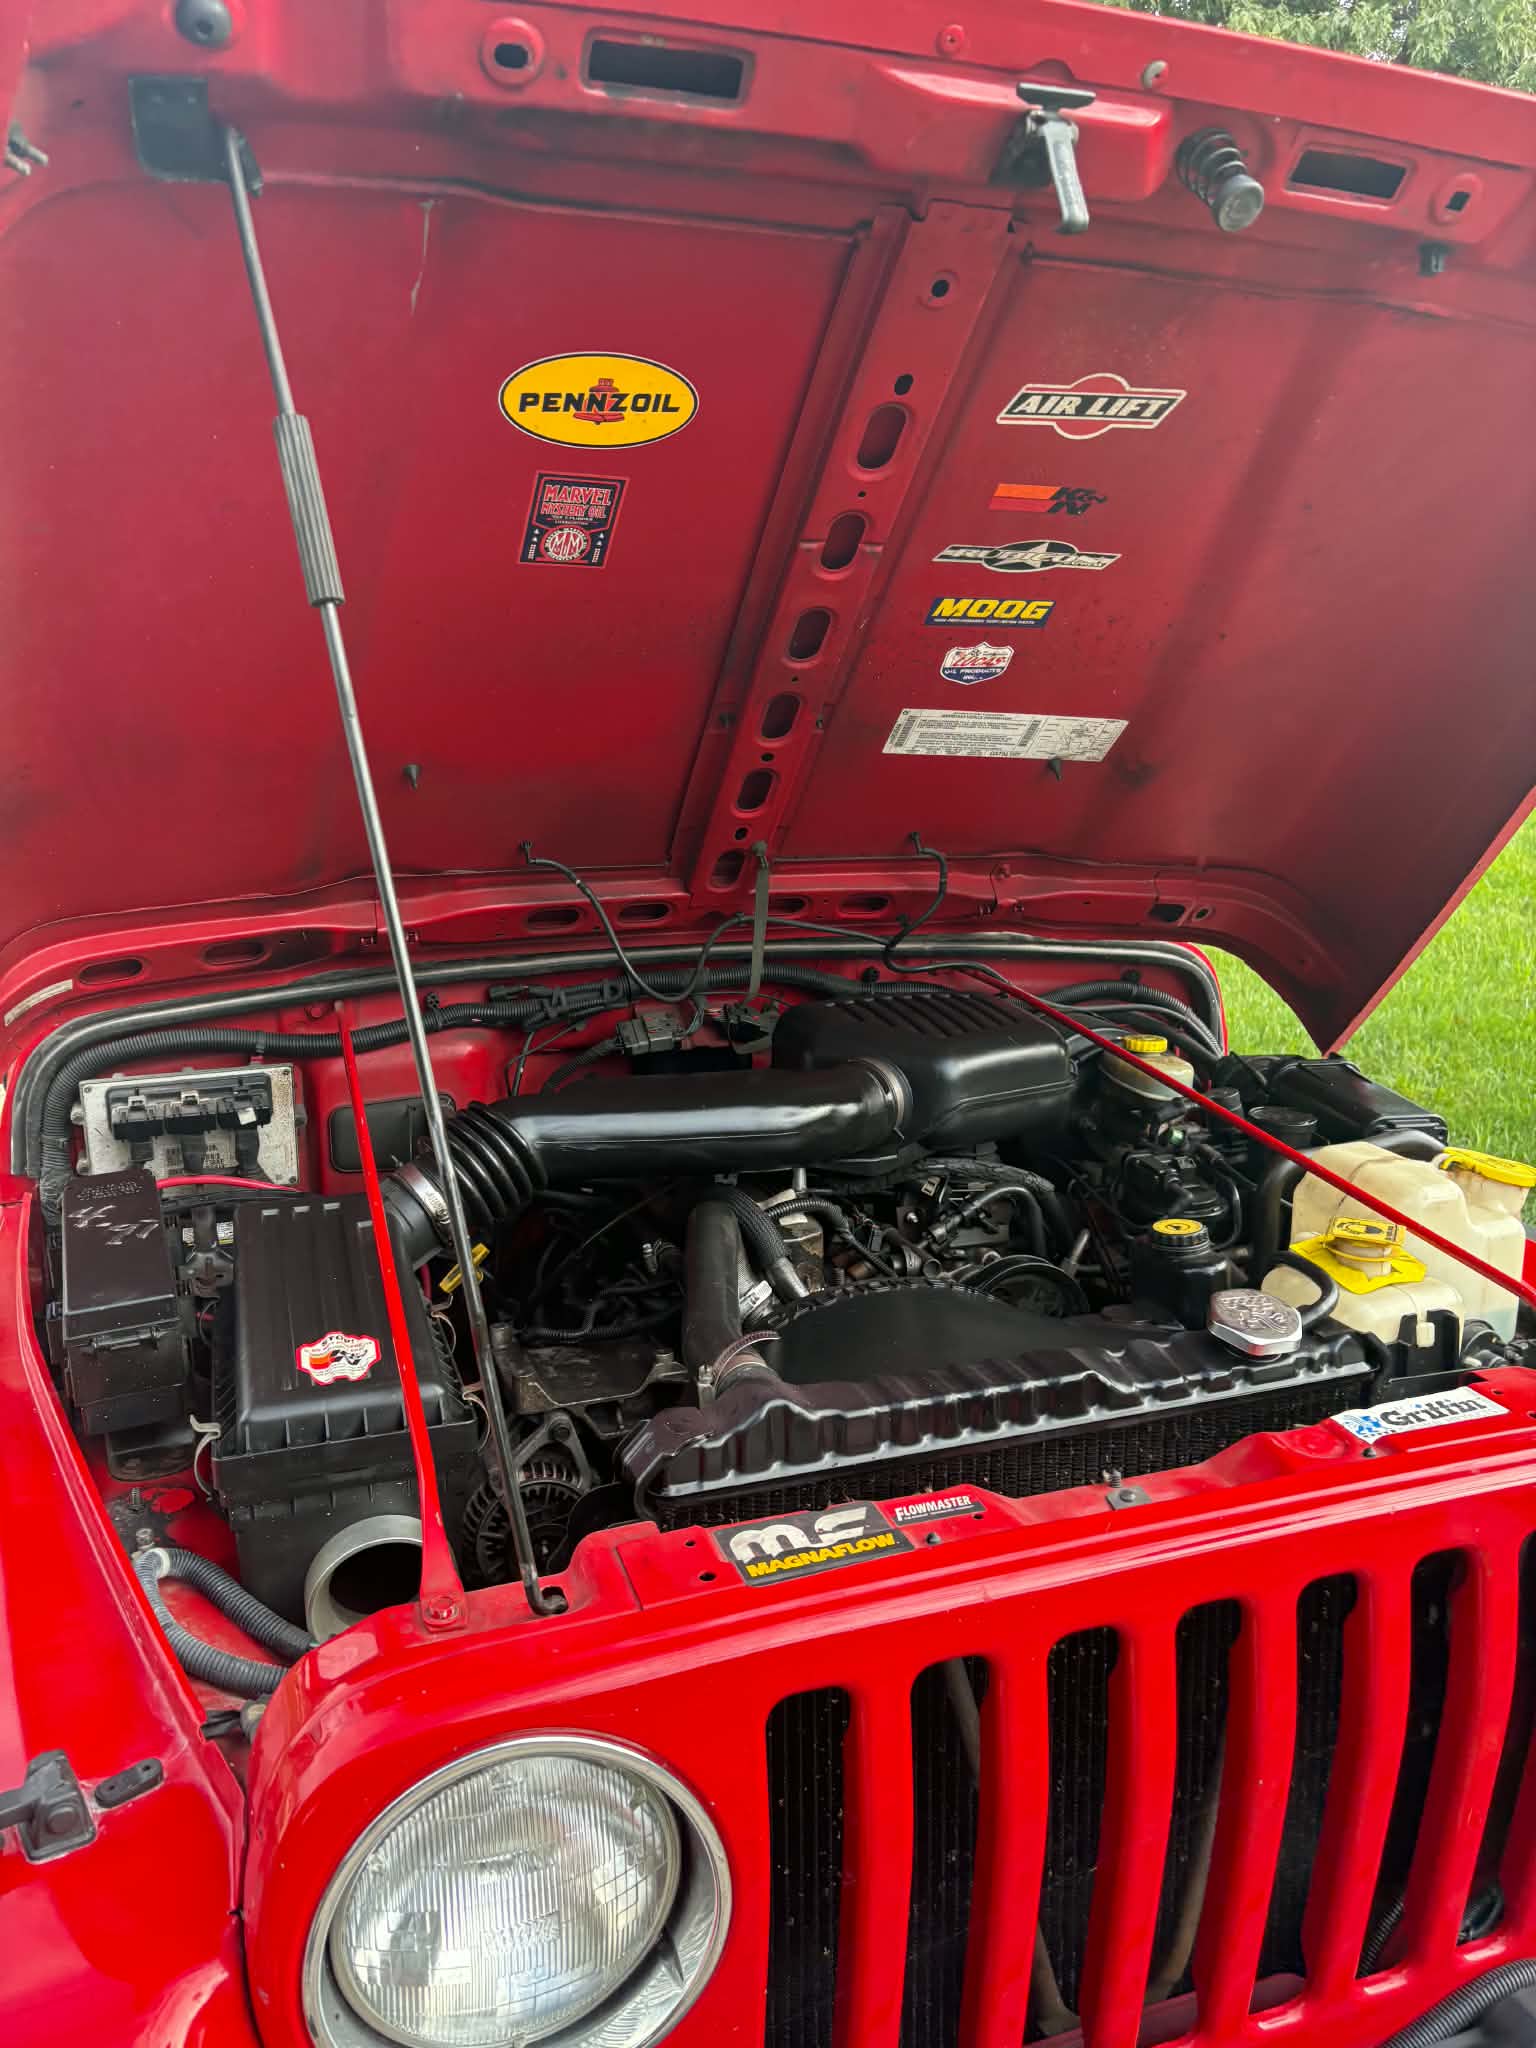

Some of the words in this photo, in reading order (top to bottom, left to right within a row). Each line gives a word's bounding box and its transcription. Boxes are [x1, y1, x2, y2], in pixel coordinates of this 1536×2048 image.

[518, 392, 681, 413] PENNZOIL
[1014, 395, 1084, 417] AIR
[1085, 397, 1168, 419] LIFT
[544, 484, 612, 505] MARVEL
[540, 502, 588, 517] MYSTERY
[588, 506, 606, 519] OIL
[931, 598, 1054, 620] MOOG
[953, 656, 1007, 667] LUCAS
[1380, 1399, 1487, 1426] Griffin
[894, 1495, 972, 1522] FLOWMASTER
[746, 1532, 895, 1577] MAGNAFLOW
